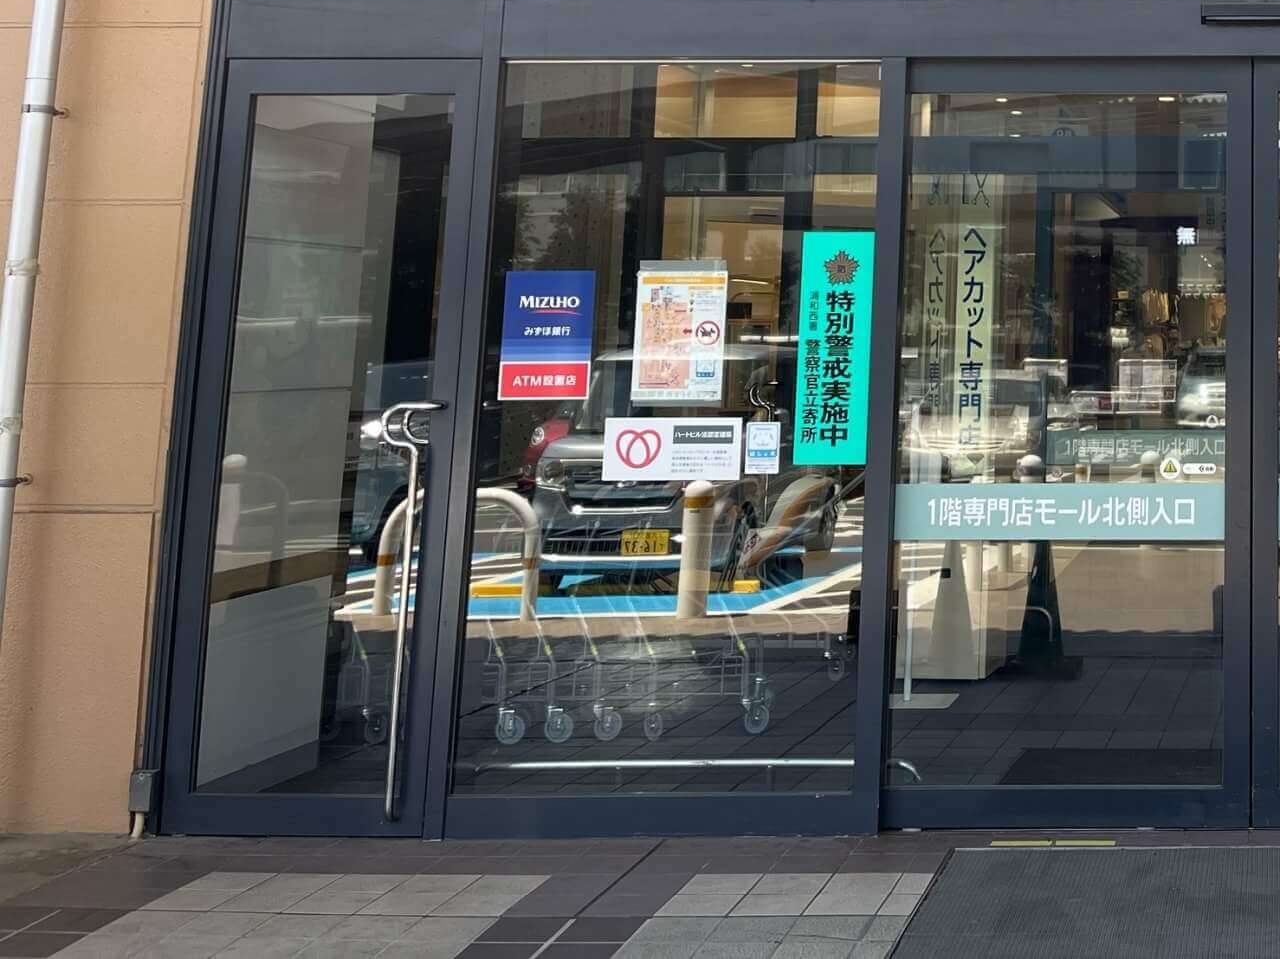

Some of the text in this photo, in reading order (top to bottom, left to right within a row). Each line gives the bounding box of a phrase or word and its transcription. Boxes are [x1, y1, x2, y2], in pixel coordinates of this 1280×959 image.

[519, 295, 581, 309] MIZUHO
[524, 326, 571, 337] みずほ銀行
[958, 227, 988, 446] ヘアカット専門店
[512, 374, 577, 387] ATM設置店
[820, 291, 855, 447] 特別警戒実施中
[800, 338, 821, 444] 警察官立寄所
[927, 497, 1196, 528] 1階専門店モール北側入口
